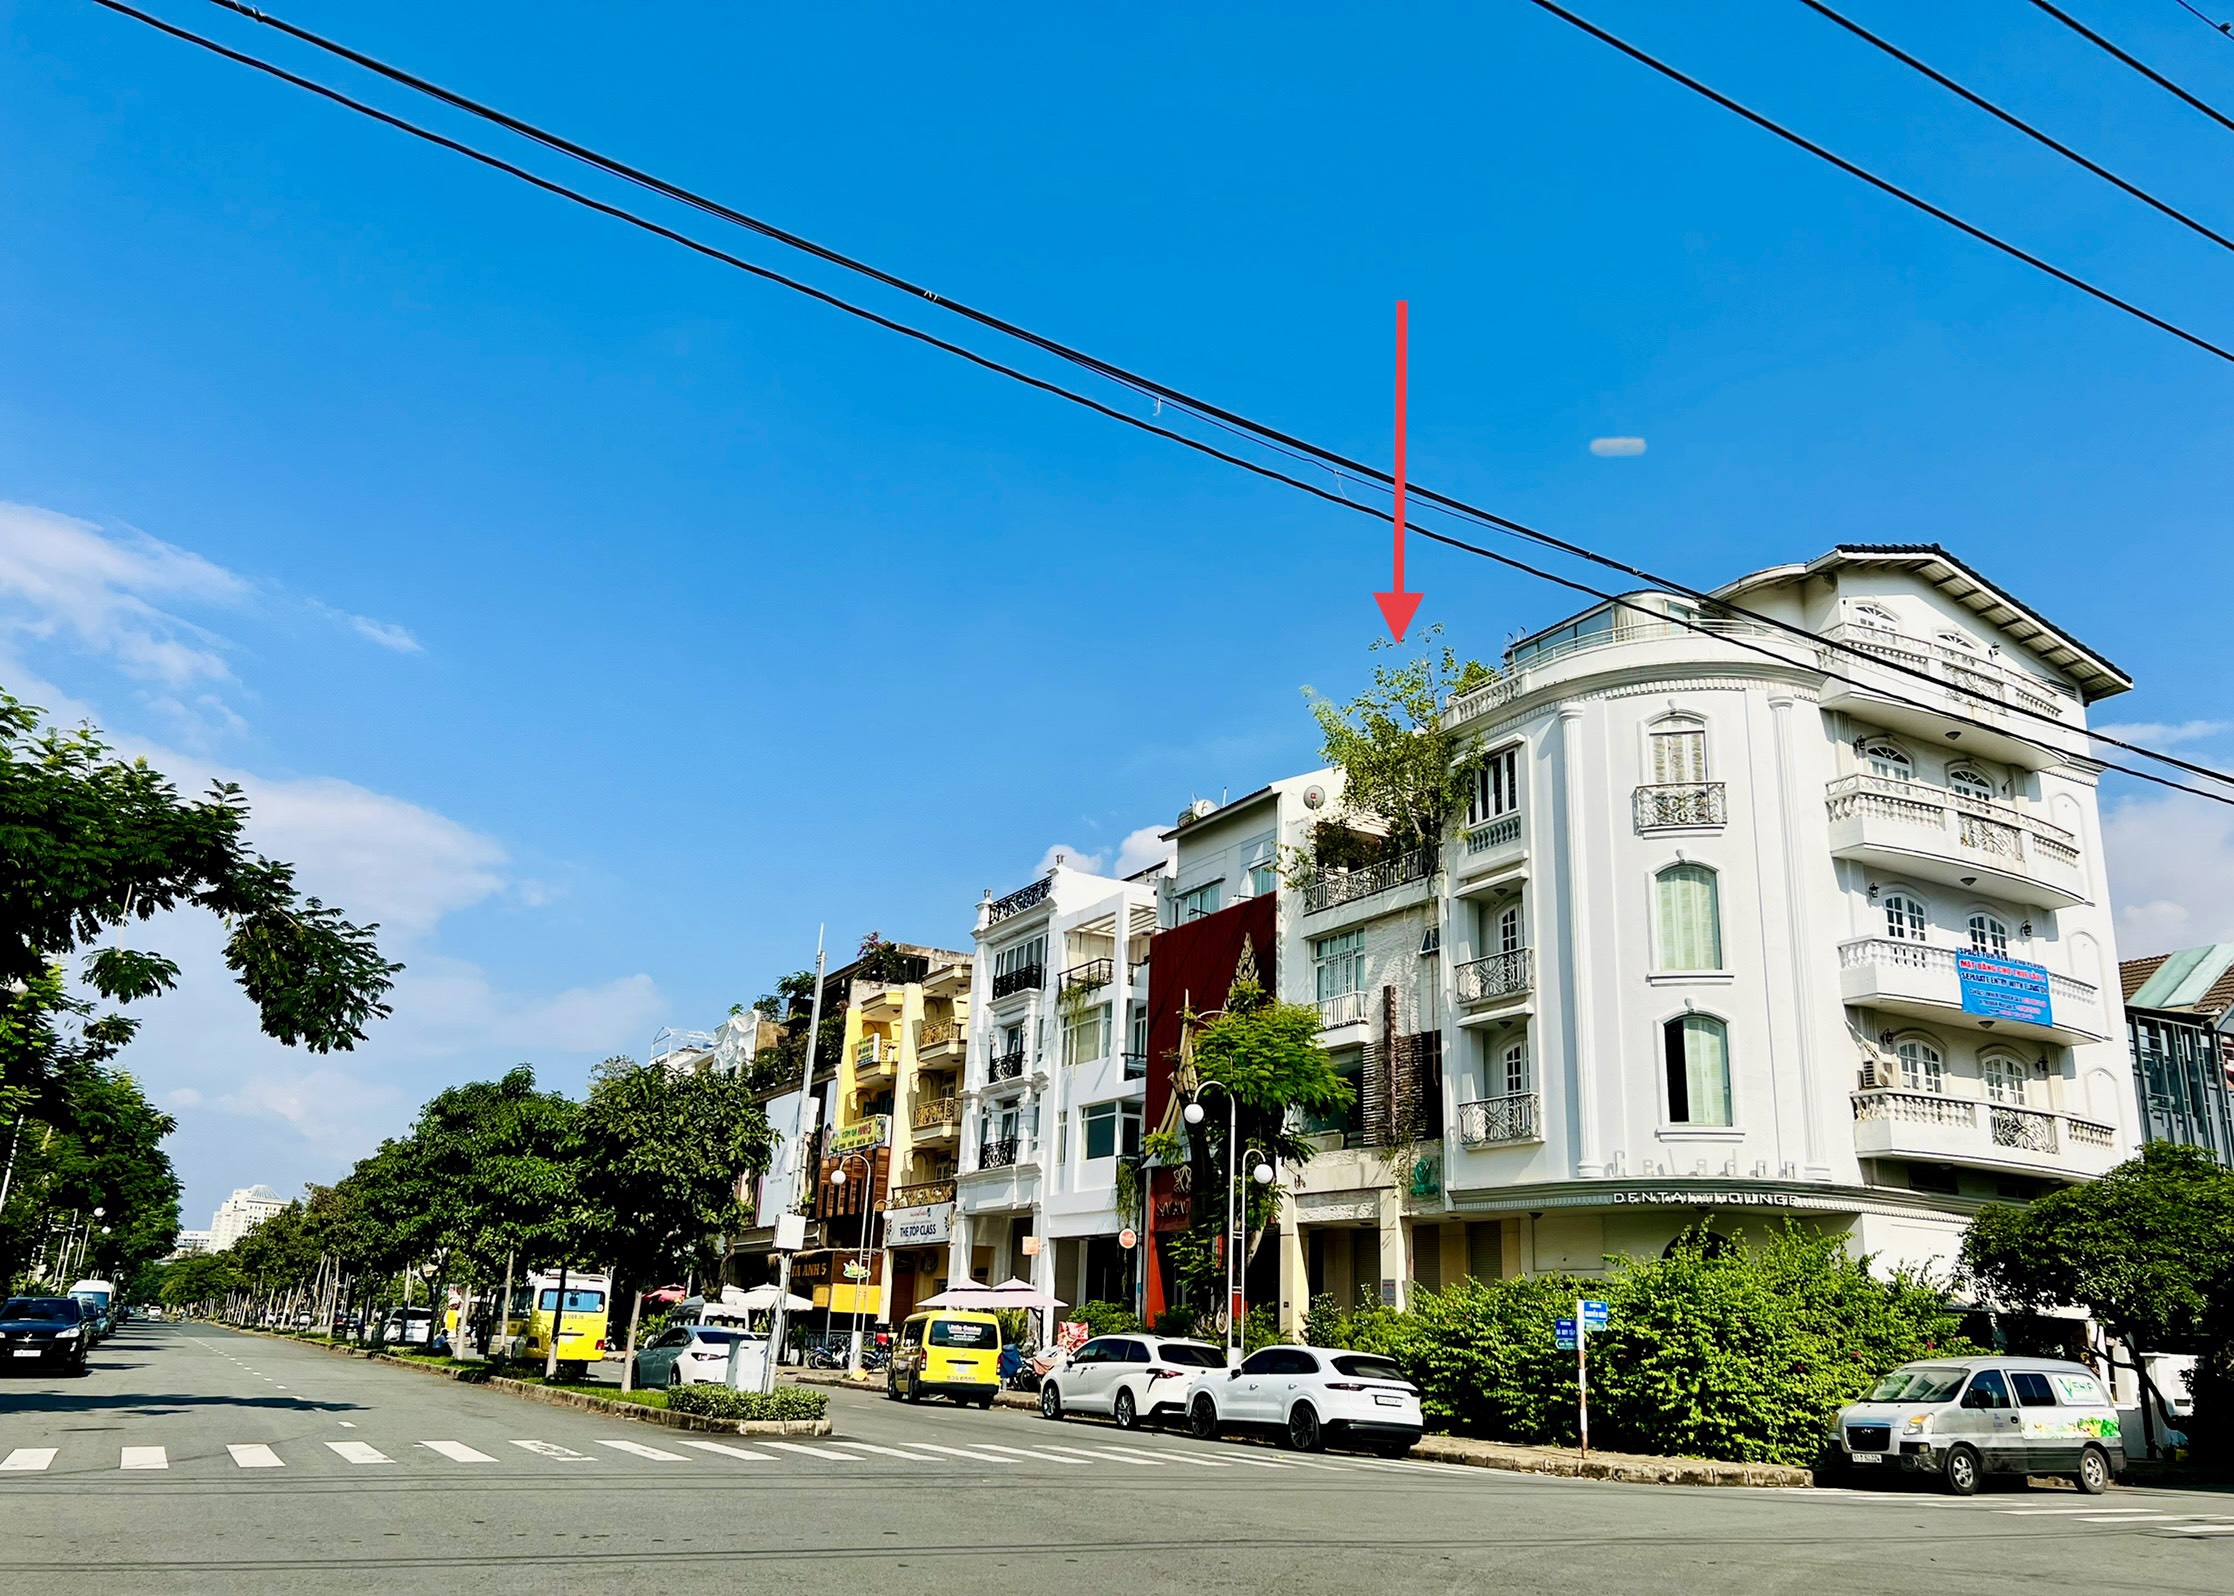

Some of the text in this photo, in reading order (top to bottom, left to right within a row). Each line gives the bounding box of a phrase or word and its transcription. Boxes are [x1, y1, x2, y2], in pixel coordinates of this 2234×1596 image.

[1613, 1191, 1698, 1205] DENTAL
[900, 1226, 909, 1237] THE
[910, 1225, 919, 1237] TOP
[920, 1223, 936, 1236] CLASS
